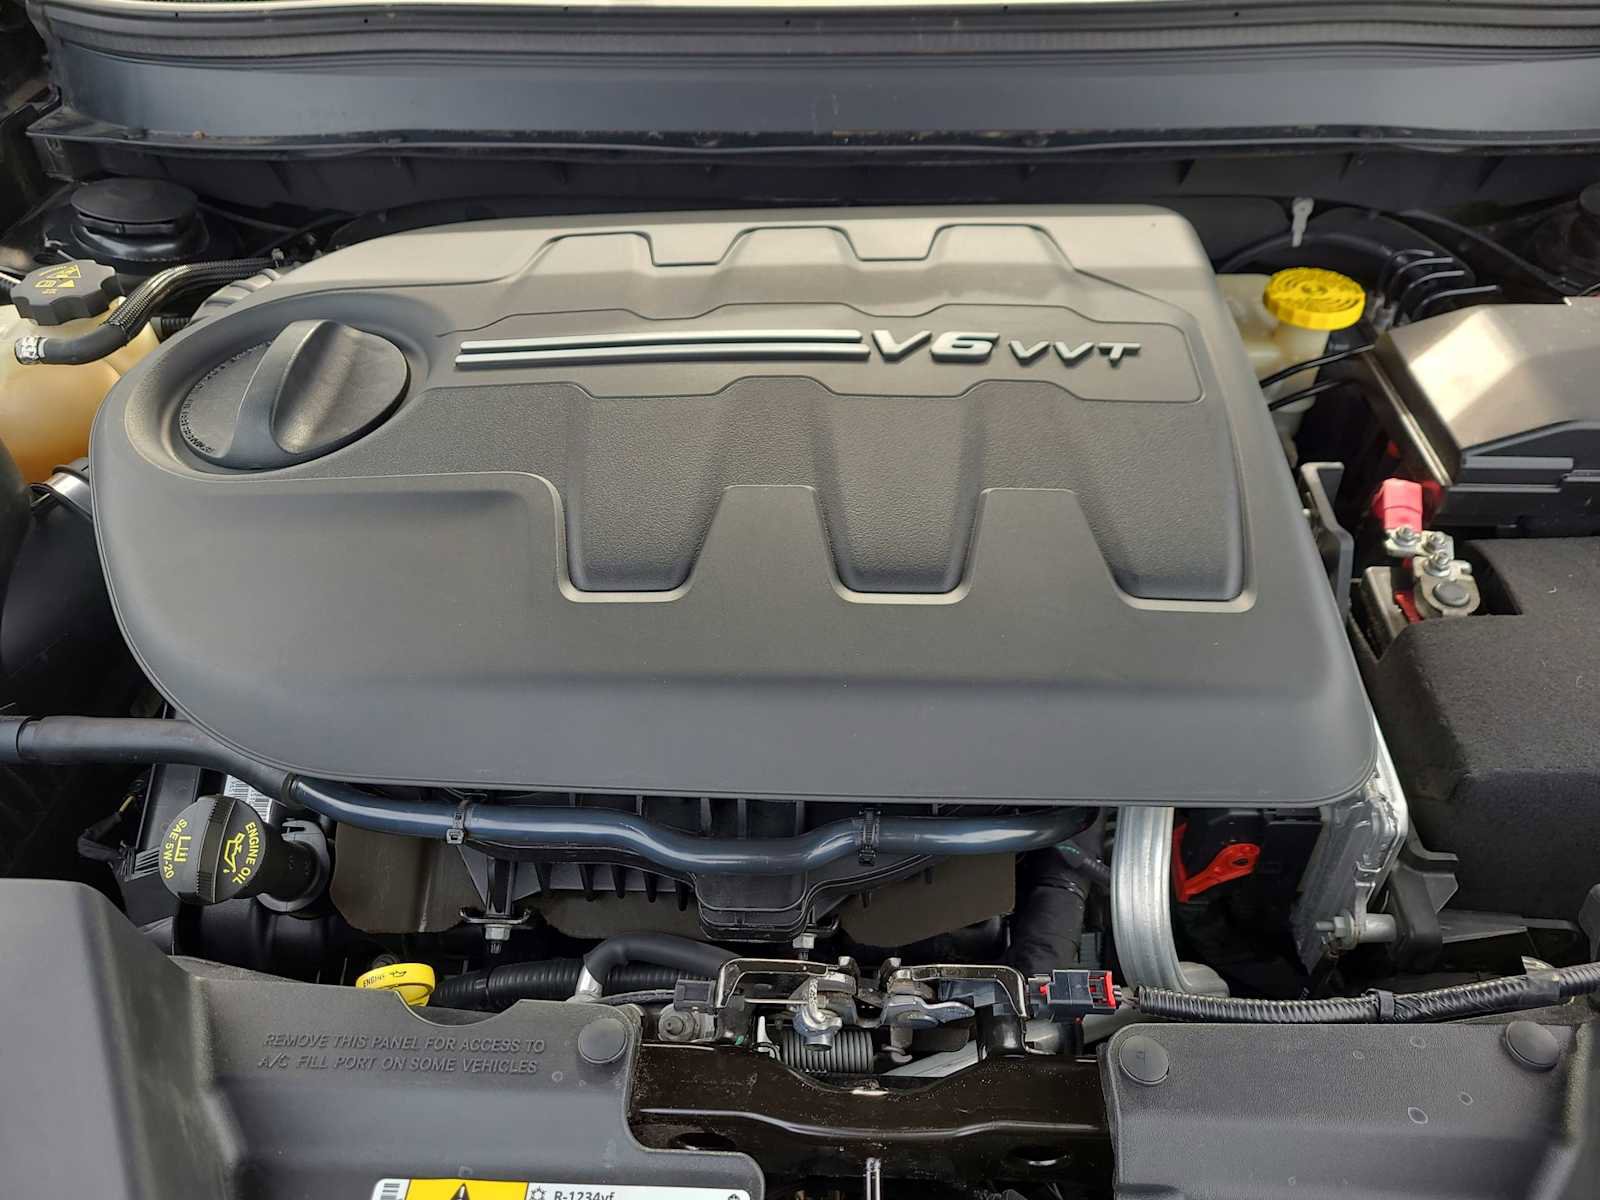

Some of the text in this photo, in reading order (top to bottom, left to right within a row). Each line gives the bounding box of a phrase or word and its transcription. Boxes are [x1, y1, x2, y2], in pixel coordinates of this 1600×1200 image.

[871, 329, 1142, 367] V6 VVT
[162, 818, 189, 880] SAE 5W-20
[244, 821, 261, 866] ENGINE
[231, 866, 252, 885] OIL
[263, 1033, 546, 1054] REMOVE THIS PANEL FOR ACCESS TO
[257, 1053, 538, 1075] A/C FILL PORT ON SOME VEHICLES
